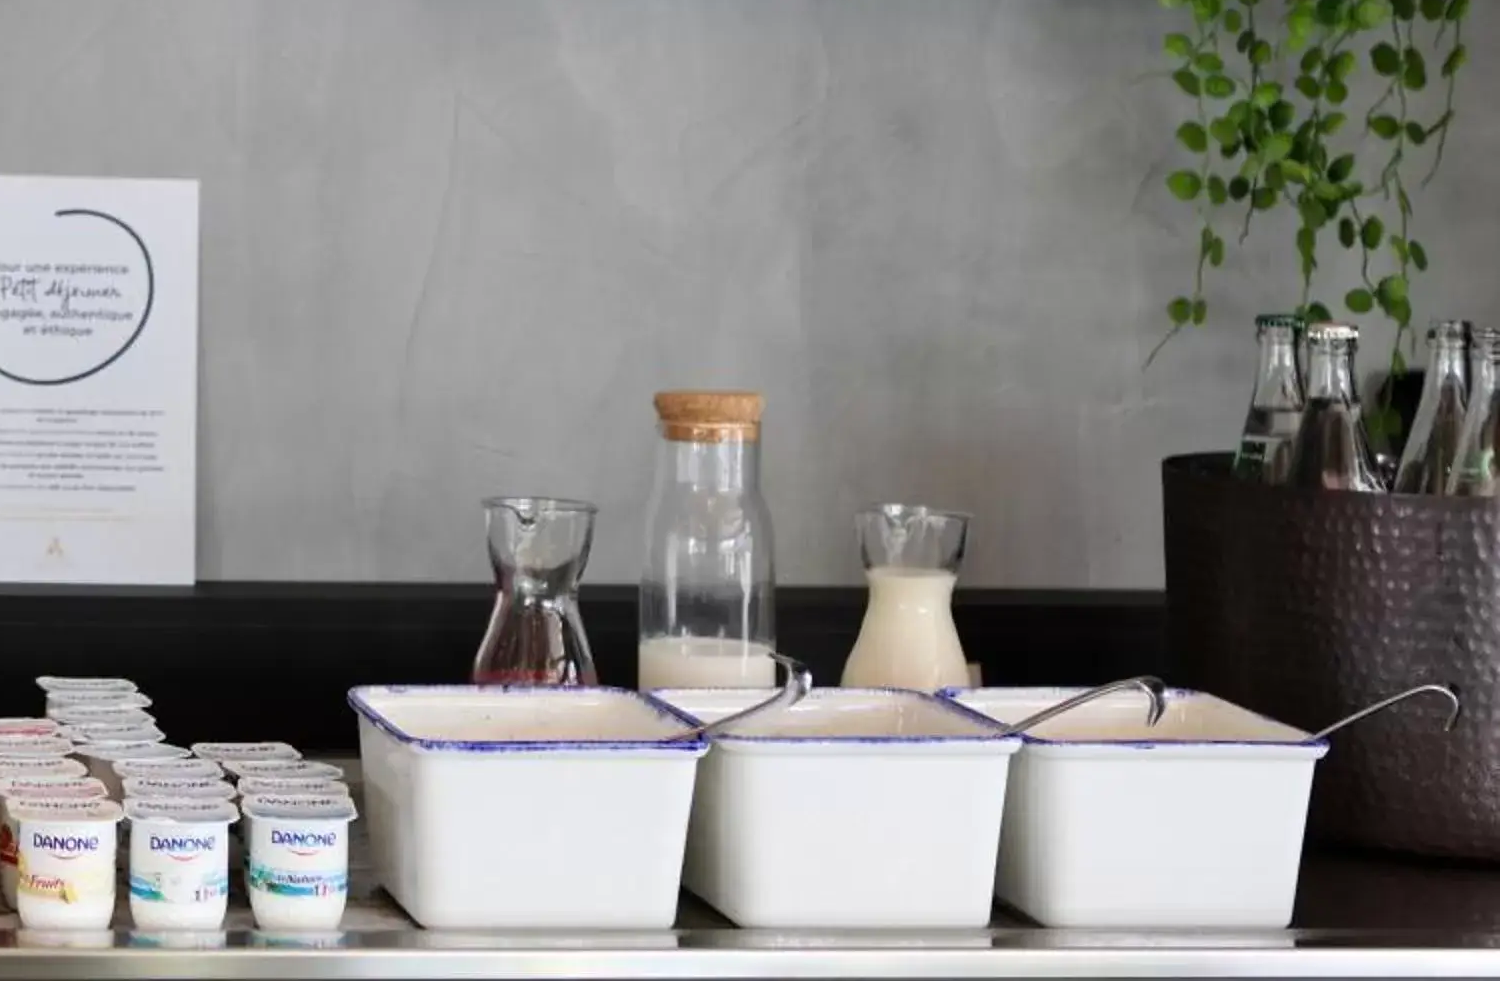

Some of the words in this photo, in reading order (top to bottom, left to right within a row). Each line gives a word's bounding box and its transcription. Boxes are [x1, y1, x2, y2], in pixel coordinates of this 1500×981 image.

[24, 261, 50, 273] une
[32, 833, 100, 851] DANONE
[149, 834, 216, 851] DANONE
[270, 829, 337, 847] DANONE
